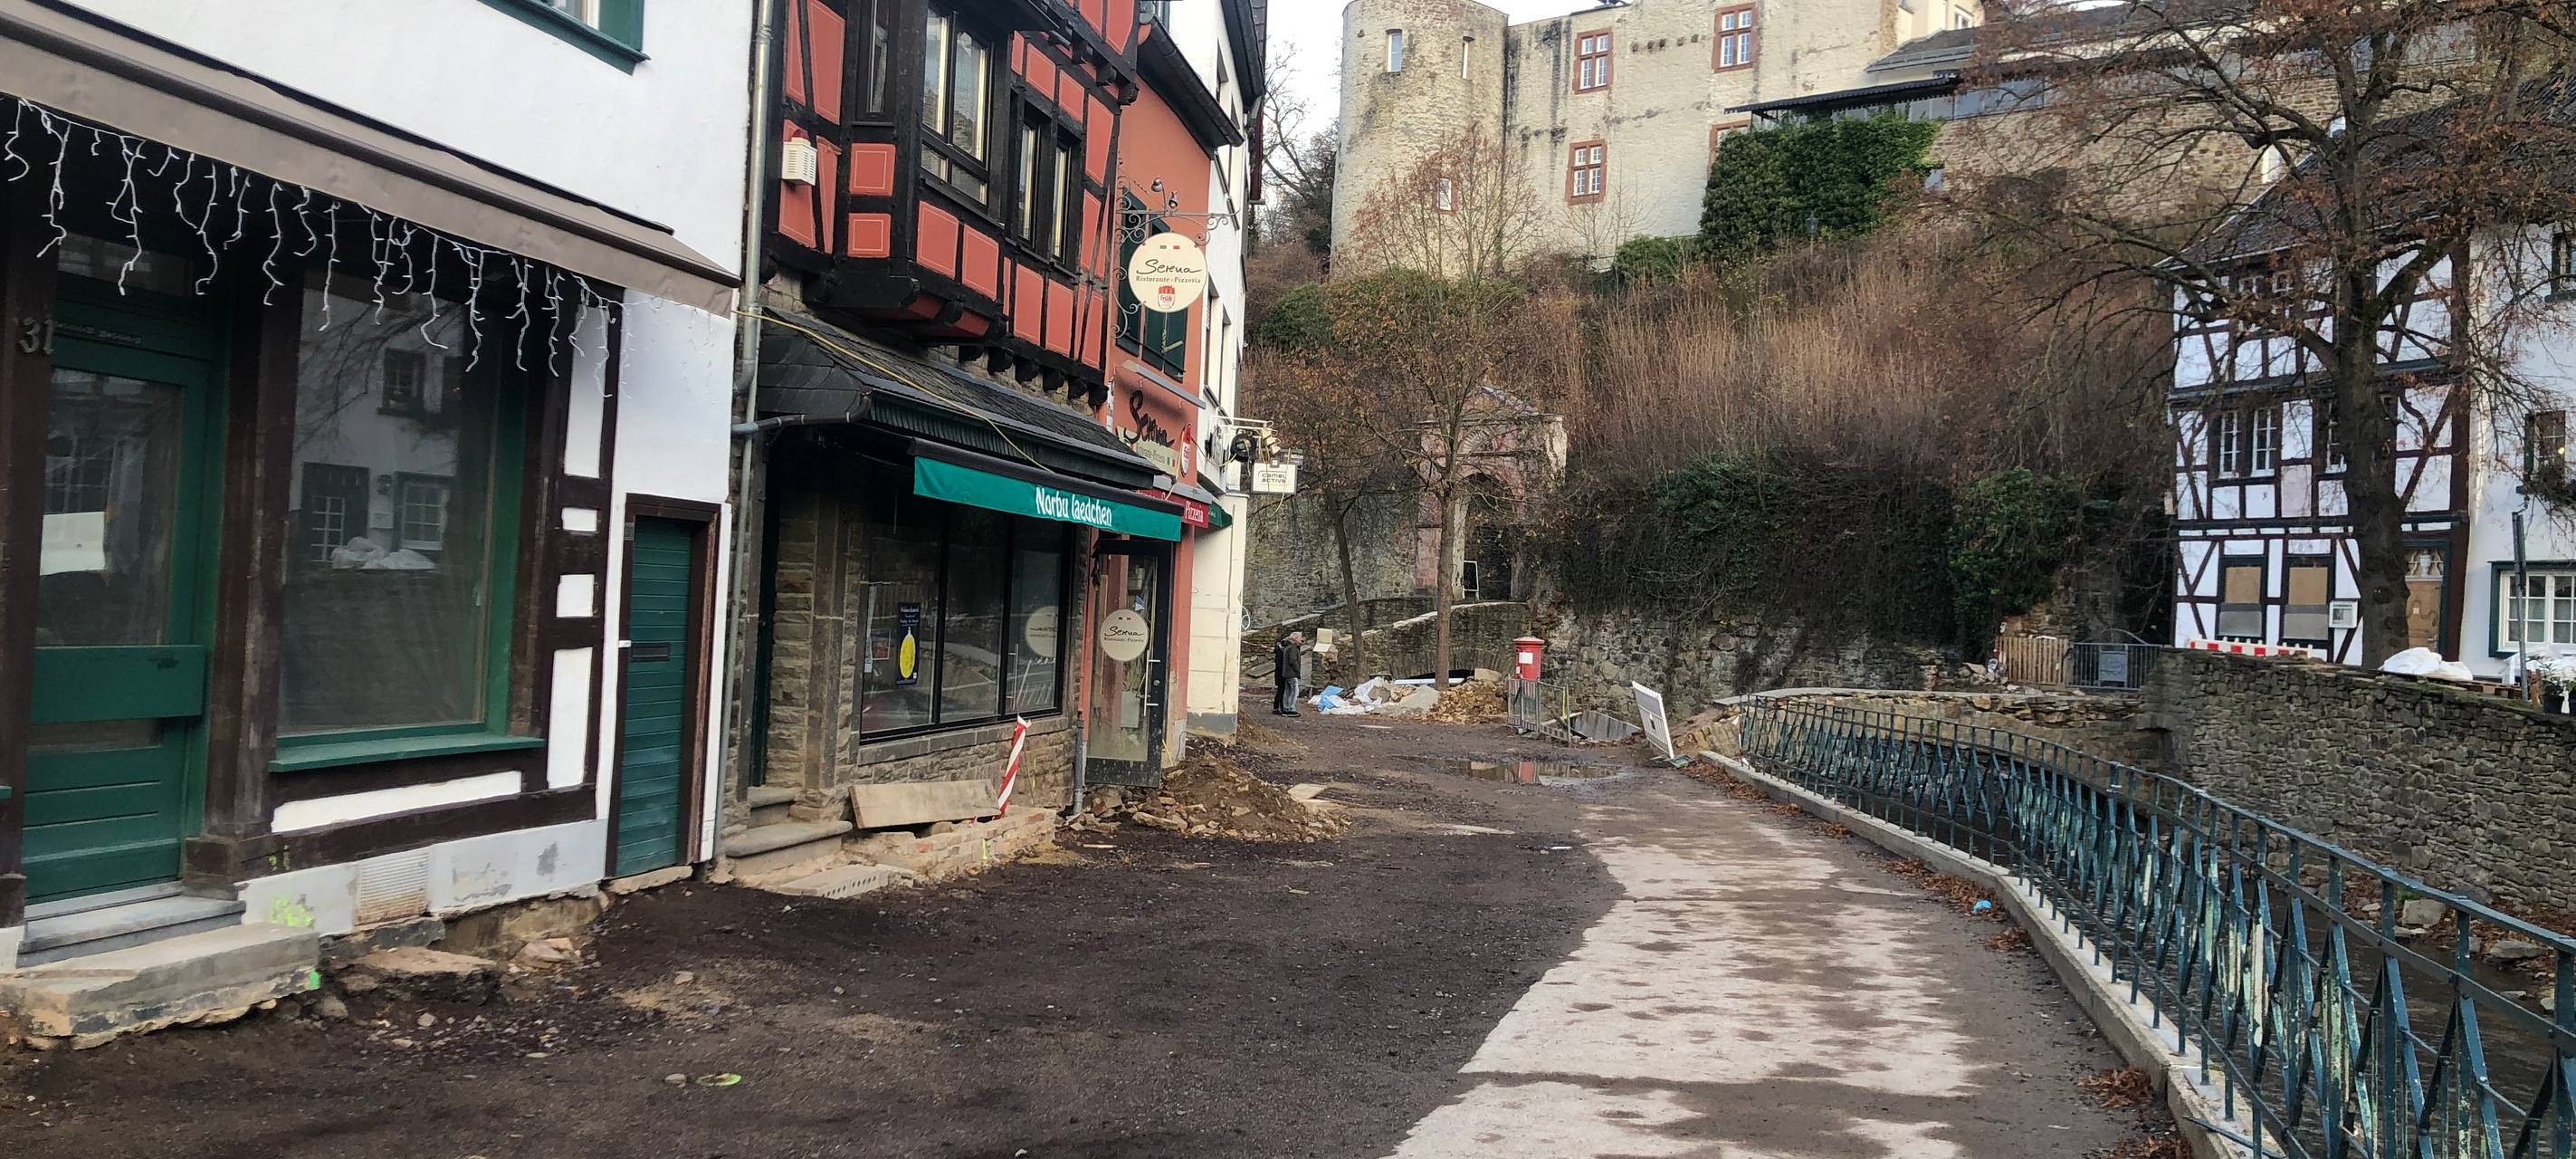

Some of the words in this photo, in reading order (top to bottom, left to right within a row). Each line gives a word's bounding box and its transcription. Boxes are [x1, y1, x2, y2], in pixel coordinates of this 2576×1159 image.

[20, 317, 54, 355] 31
[1036, 487, 1069, 518] Norbu
[1072, 493, 1111, 526] laedchen
[1185, 501, 1204, 522] Pizzeria
